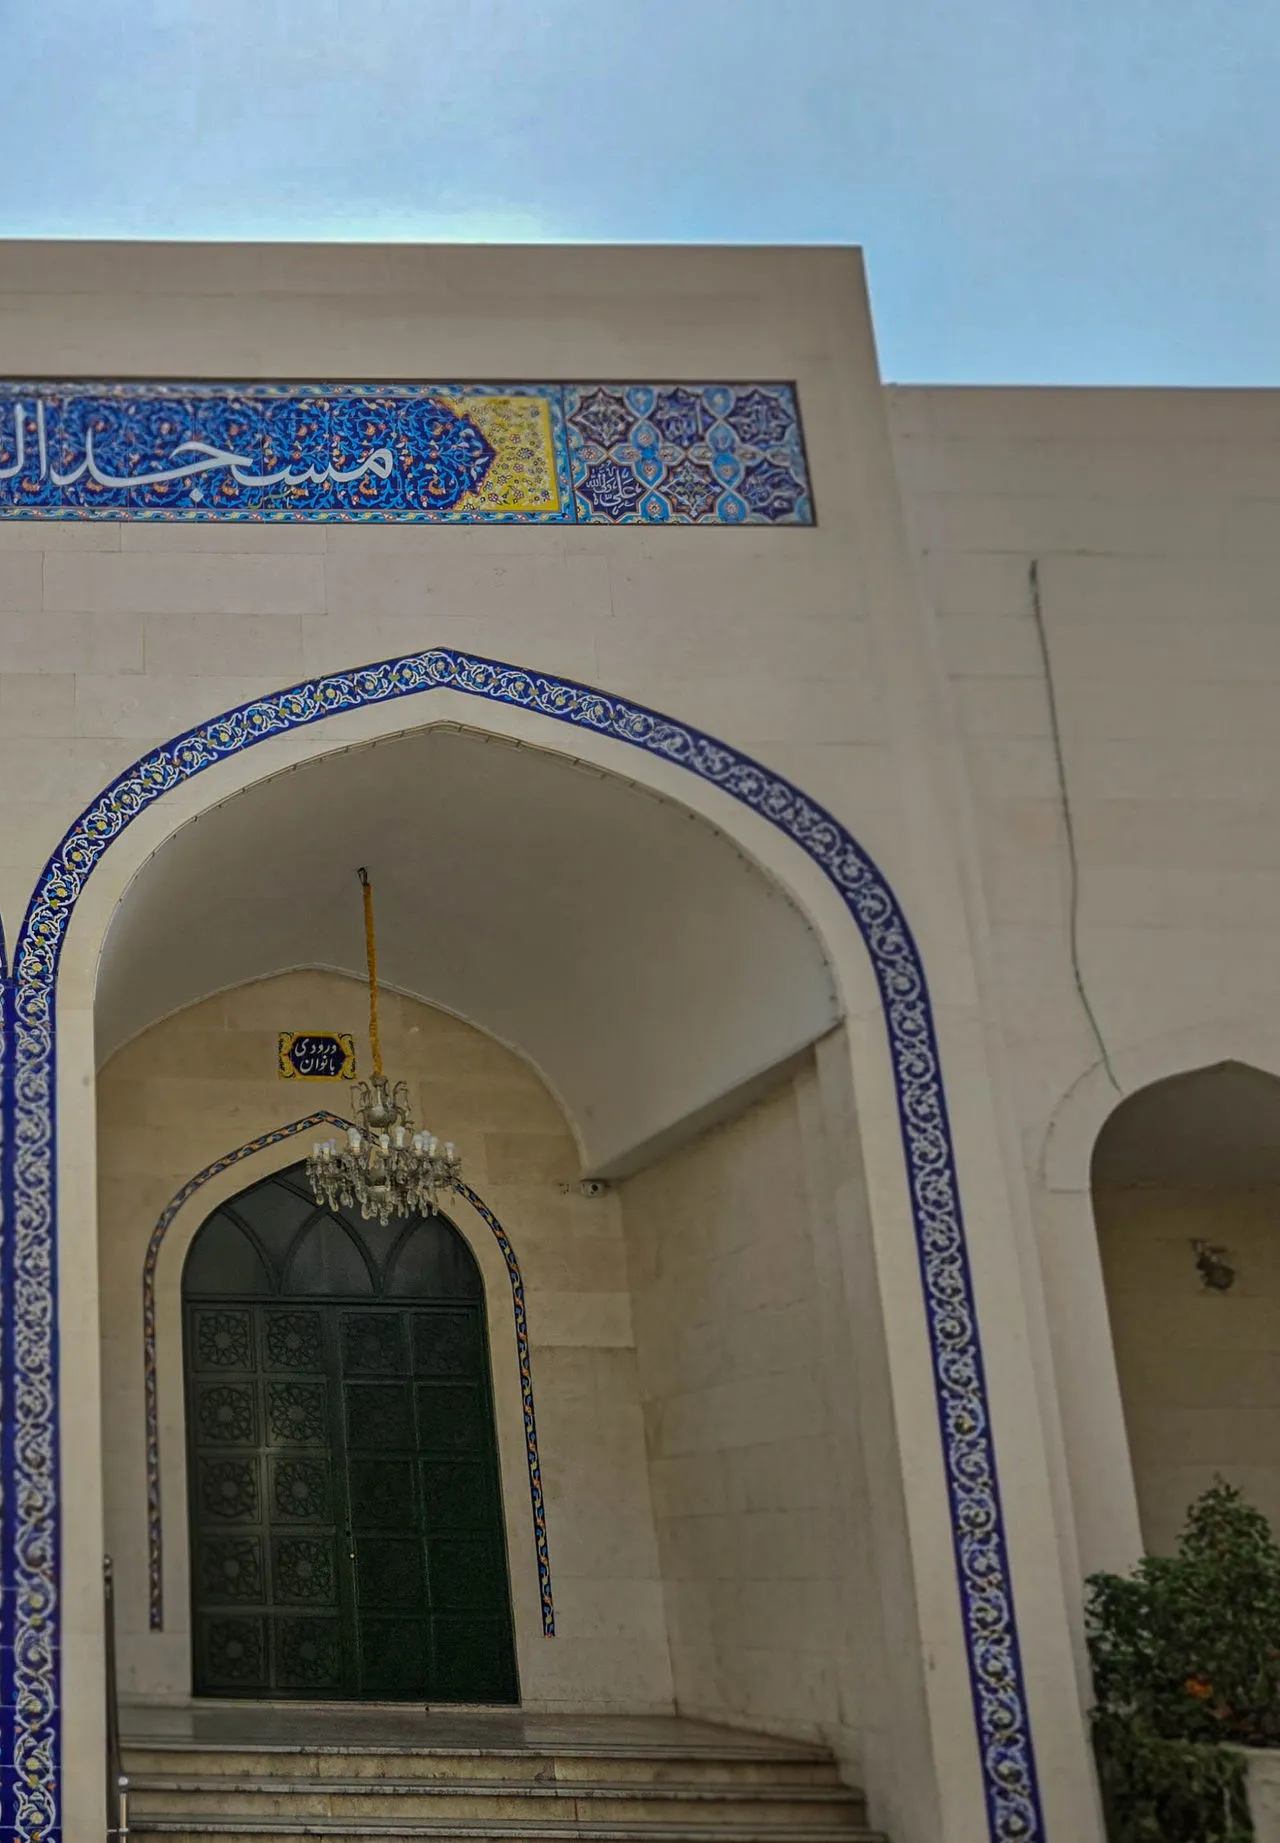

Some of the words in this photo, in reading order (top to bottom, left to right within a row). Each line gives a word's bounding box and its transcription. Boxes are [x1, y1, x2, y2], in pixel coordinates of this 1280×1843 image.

[50, 427, 393, 503] مسجد
[294, 1038, 337, 1057] ورودی
[300, 1055, 335, 1075] بانوان
